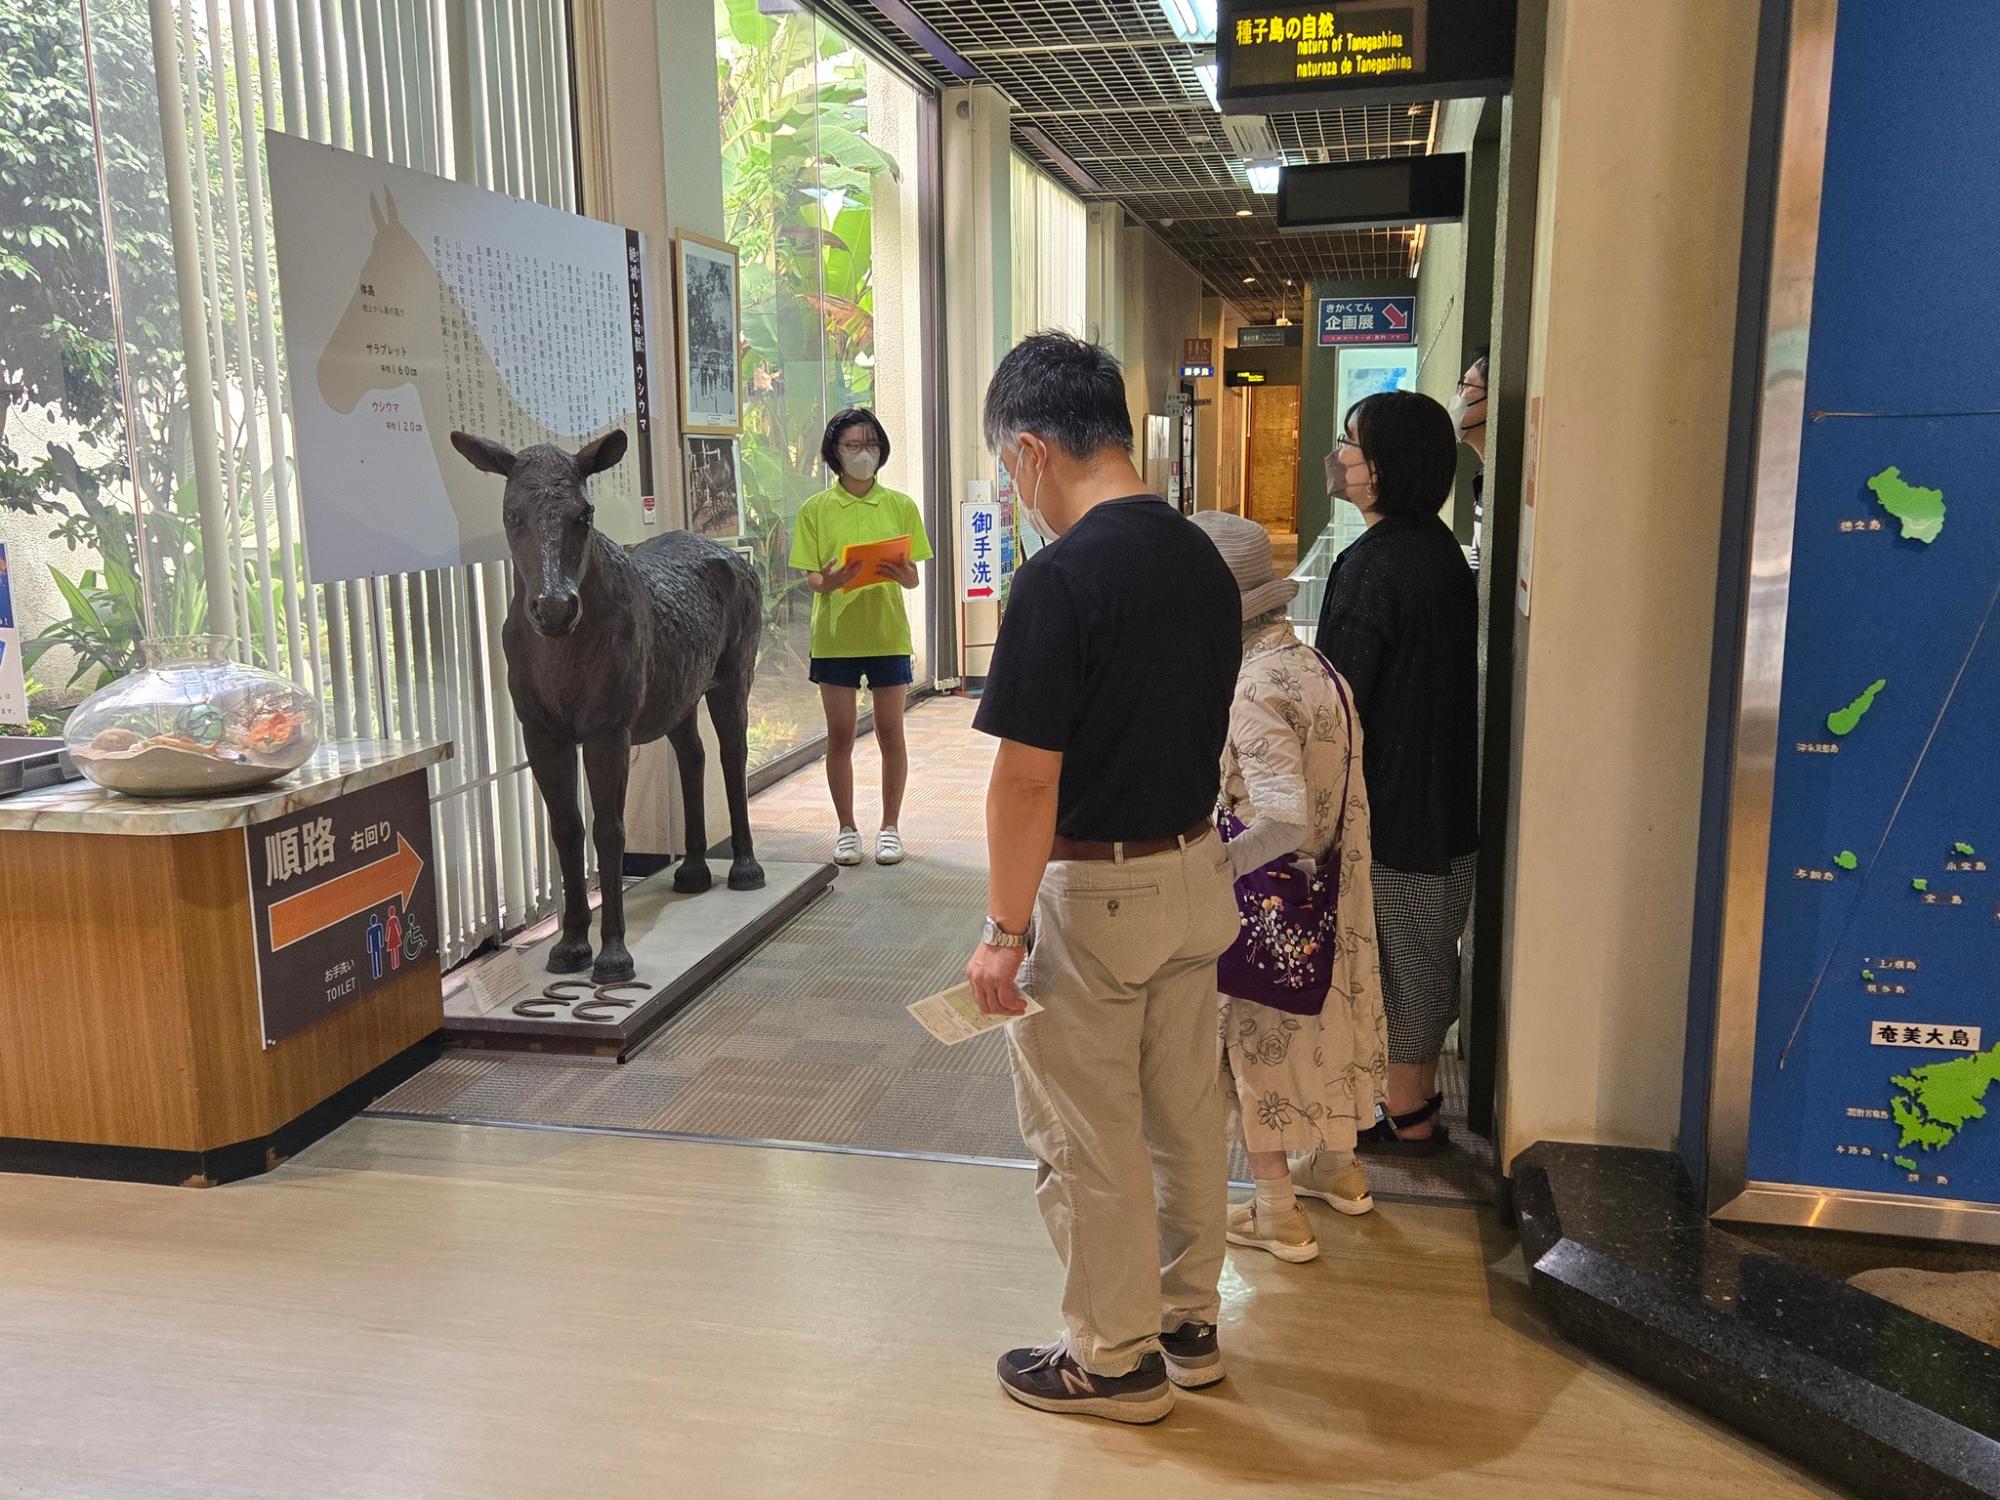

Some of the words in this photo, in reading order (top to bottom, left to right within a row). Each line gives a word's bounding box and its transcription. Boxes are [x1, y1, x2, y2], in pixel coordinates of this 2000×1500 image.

[1235, 12, 1334, 46] 種子島の自然
[1297, 38, 1328, 55] nature
[1332, 34, 1342, 53] of
[1347, 30, 1403, 52] Tanegashima
[1296, 60, 1338, 77] natureza
[1341, 56, 1352, 74] de
[1356, 53, 1412, 74] Tanegashima
[360, 283, 375, 297] 体高
[1326, 303, 1373, 313] きかくてん
[1325, 315, 1374, 330] 企画展
[372, 401, 400, 413] ウシウマ
[636, 363, 647, 430] ウシウマ
[972, 512, 992, 584] 御手洗
[350, 821, 391, 853] 右回り
[264, 816, 336, 887] 順路
[324, 959, 356, 982] お手洗い
[325, 977, 357, 1002] TOILET
[1877, 1024, 1969, 1047] 奄美大島
